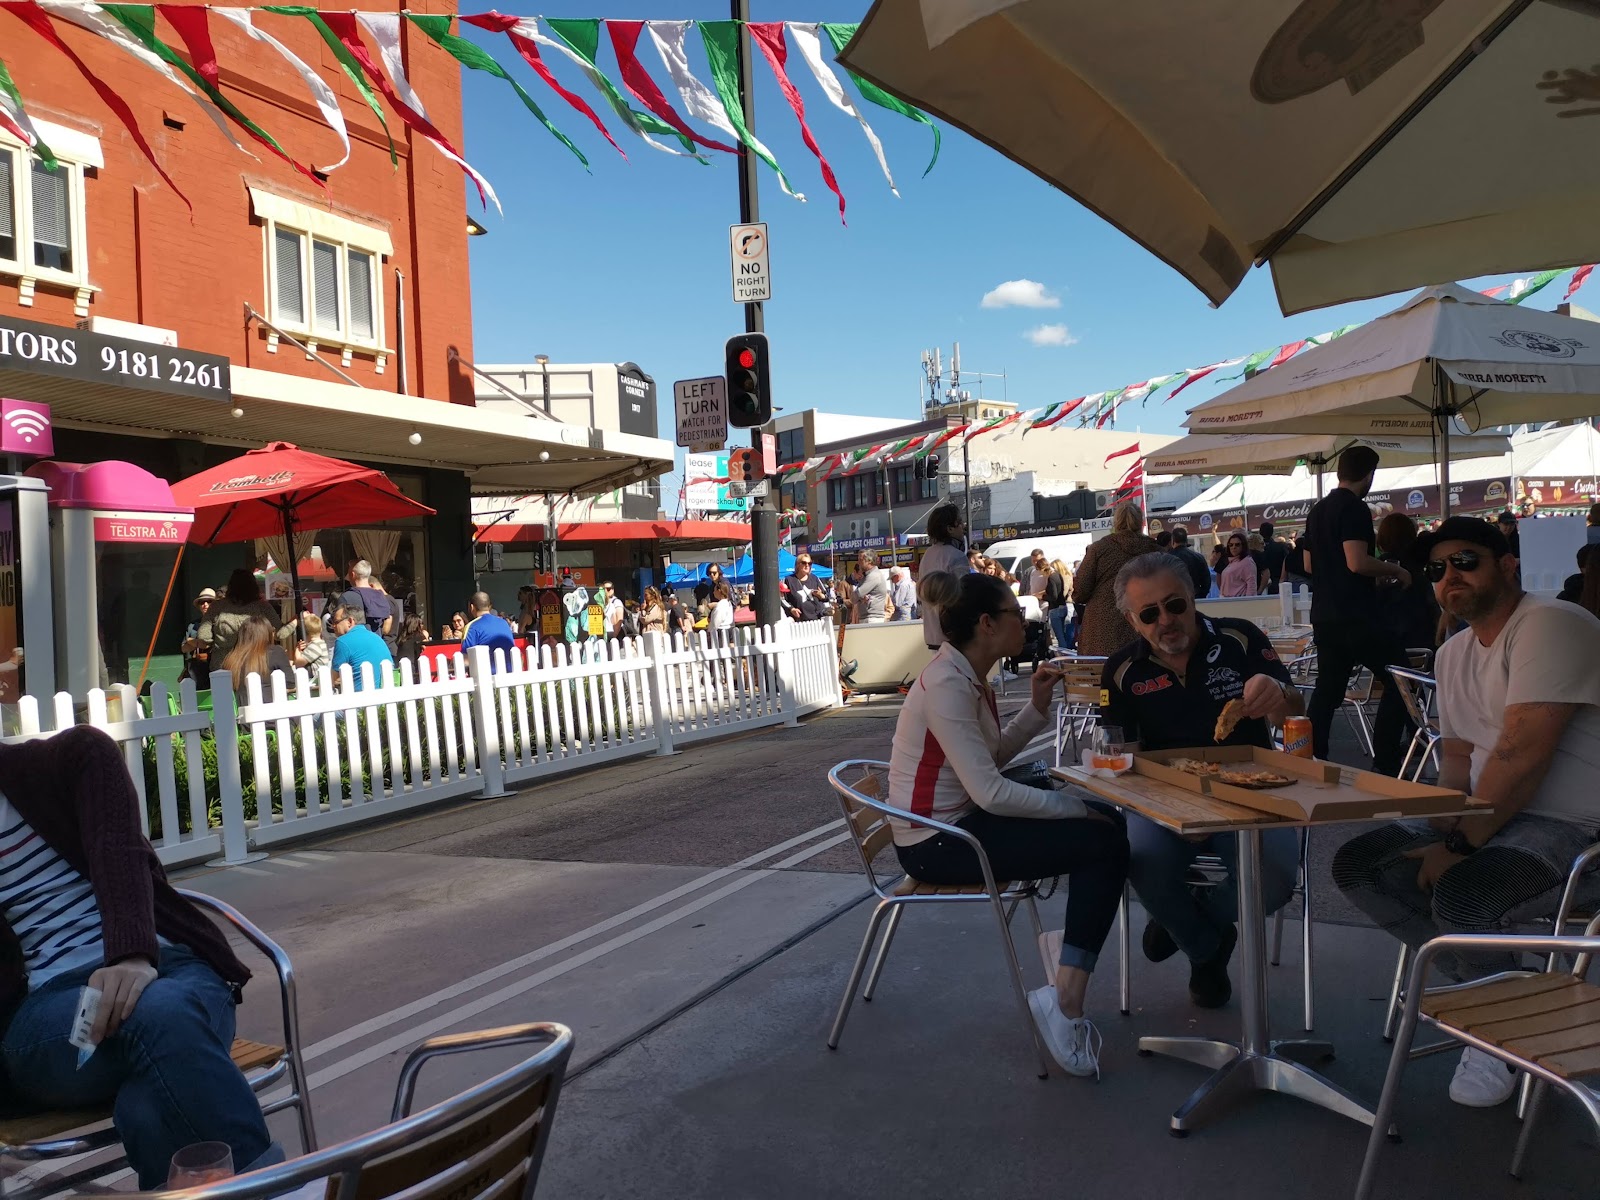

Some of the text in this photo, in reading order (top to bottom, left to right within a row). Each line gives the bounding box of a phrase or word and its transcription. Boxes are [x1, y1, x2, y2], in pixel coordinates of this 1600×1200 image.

[741, 262, 761, 275] NO
[736, 276, 766, 286] RIGHT
[739, 288, 766, 297] TURN
[0, 328, 223, 389] TORS 9181 2261
[1494, 373, 1547, 384] MORETTI
[625, 386, 645, 398] CORNER
[682, 382, 716, 399] LEFT
[682, 399, 719, 415] TURN
[681, 415, 721, 428] WATCH FOR
[1198, 410, 1264, 424] BIRRA MORETTI
[679, 428, 725, 442] PEDESTRIANS
[689, 458, 713, 467] lease
[1154, 457, 1208, 468] BIRRA MORETTI
[1450, 486, 1464, 495] KES
[1364, 494, 1391, 502] ANNOLI
[1263, 503, 1311, 520] Crostoli
[110, 525, 156, 539] TELSTRA
[839, 539, 863, 549] CHEAPEST
[864, 536, 885, 546] CHEMIST
[542, 605, 559, 614] 0083
[1131, 673, 1173, 696] OAK
